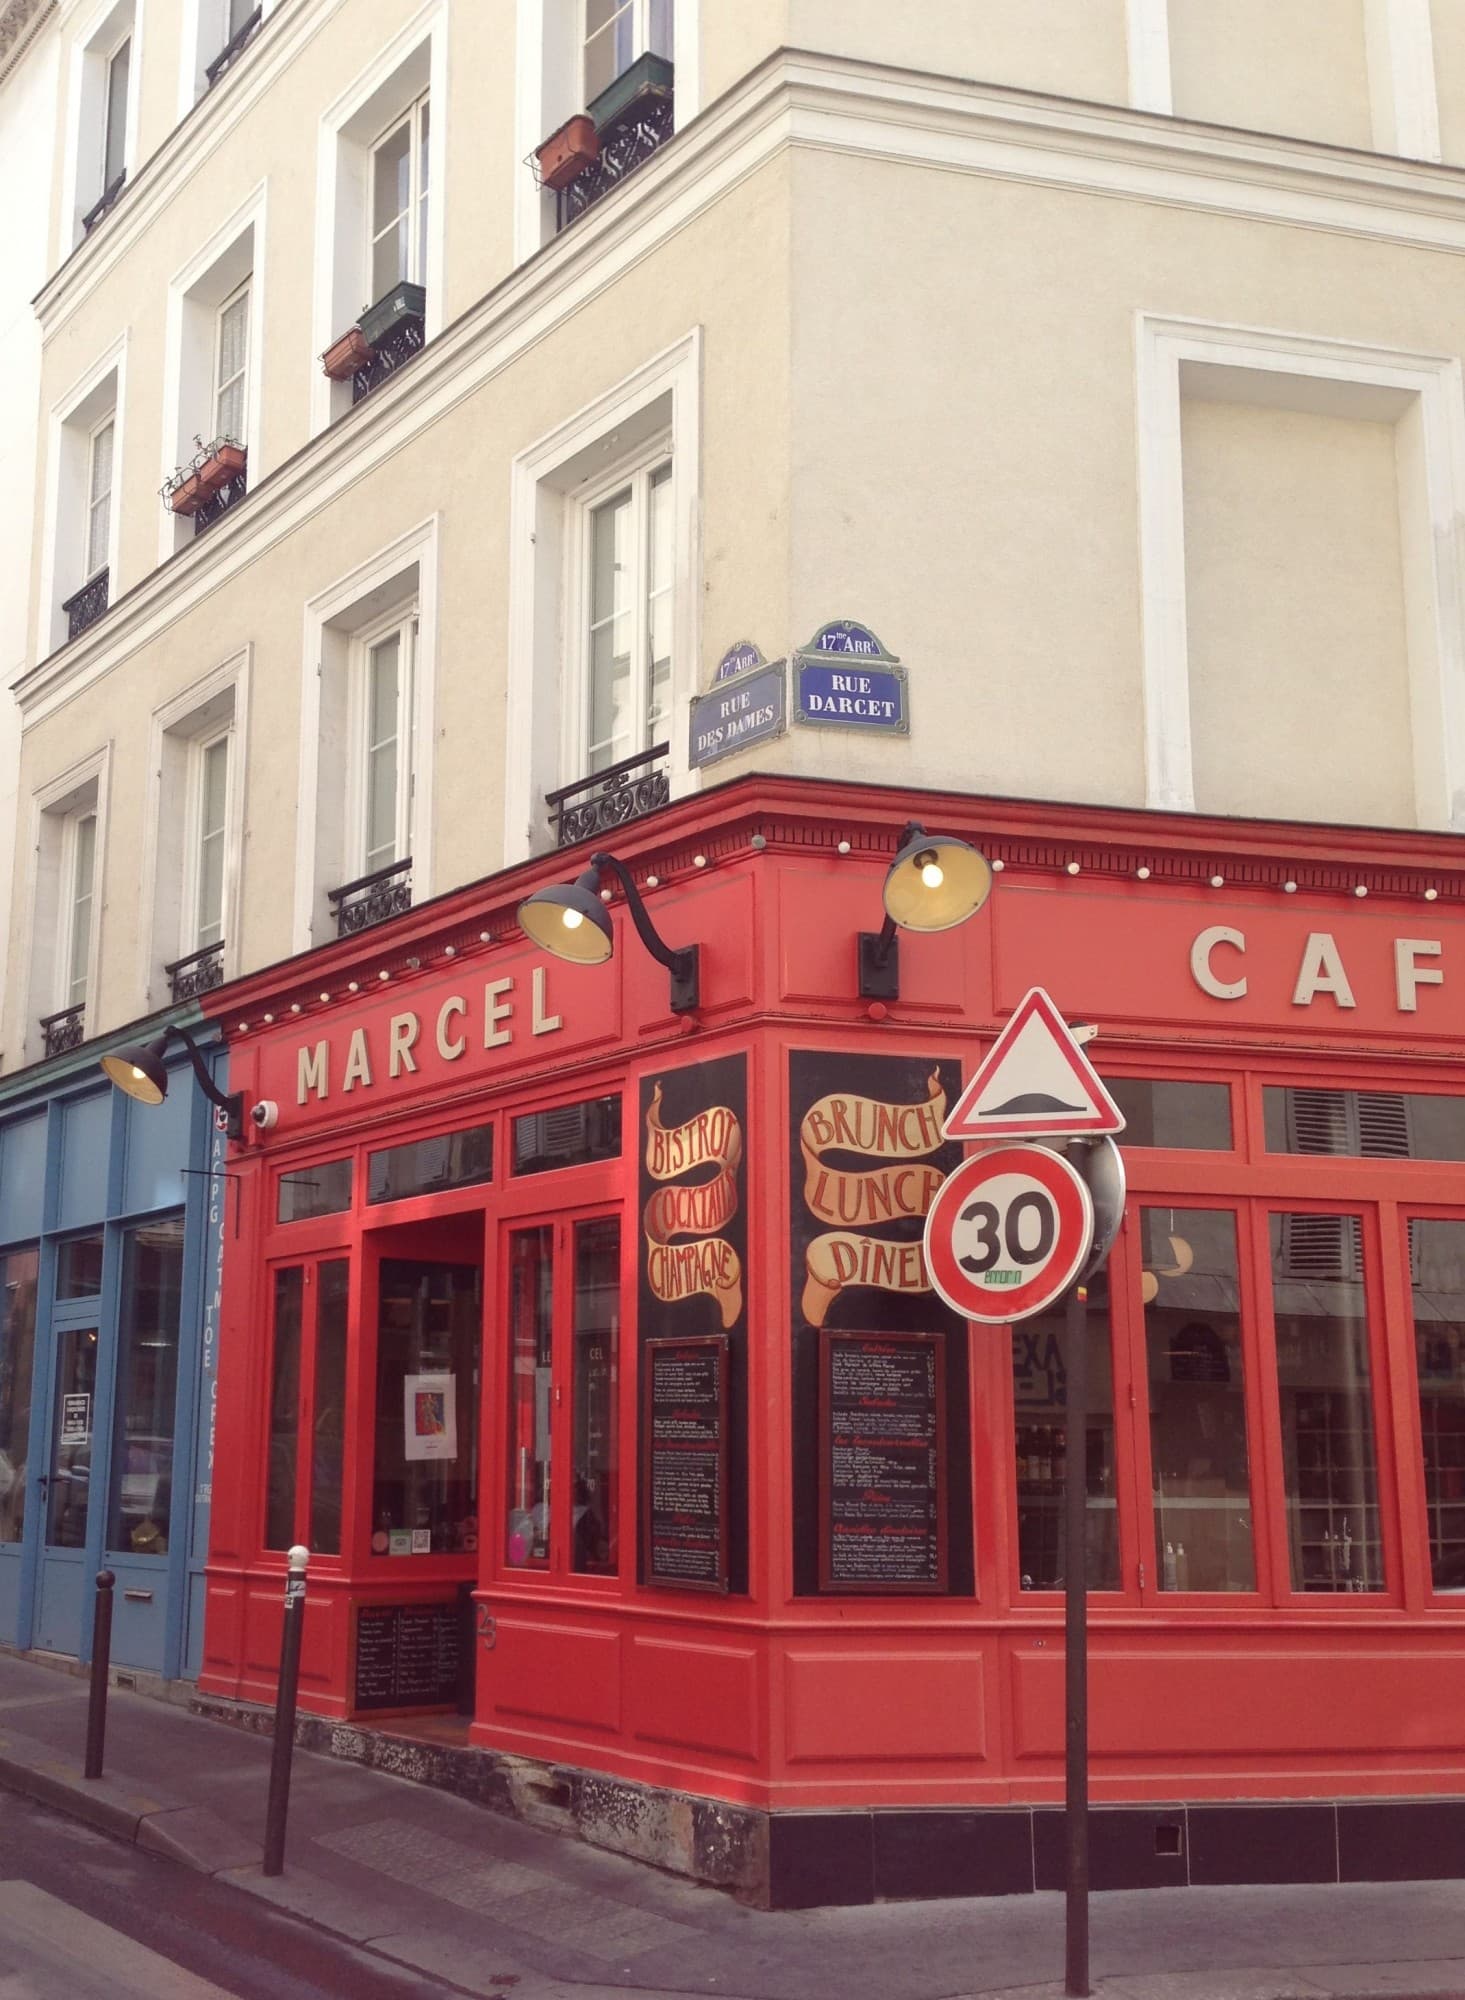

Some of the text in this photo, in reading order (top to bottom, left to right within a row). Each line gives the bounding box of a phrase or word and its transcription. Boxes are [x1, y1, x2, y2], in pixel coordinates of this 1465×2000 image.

[720, 692, 751, 718] RUE
[808, 694, 895, 717] DARCET
[831, 674, 871, 693] RUE
[698, 704, 774, 751] DES DAMES
[297, 966, 563, 1104] MARCEL
[652, 1108, 737, 1175] BISTROT
[808, 1099, 942, 1152] BRUNCH
[651, 1167, 737, 1239] COCKTAILS
[812, 1170, 945, 1223] LUNCH
[959, 1190, 1055, 1274] 30
[650, 1240, 733, 1299] CHAMPAGNE
[204, 1305, 214, 1367] TOE
